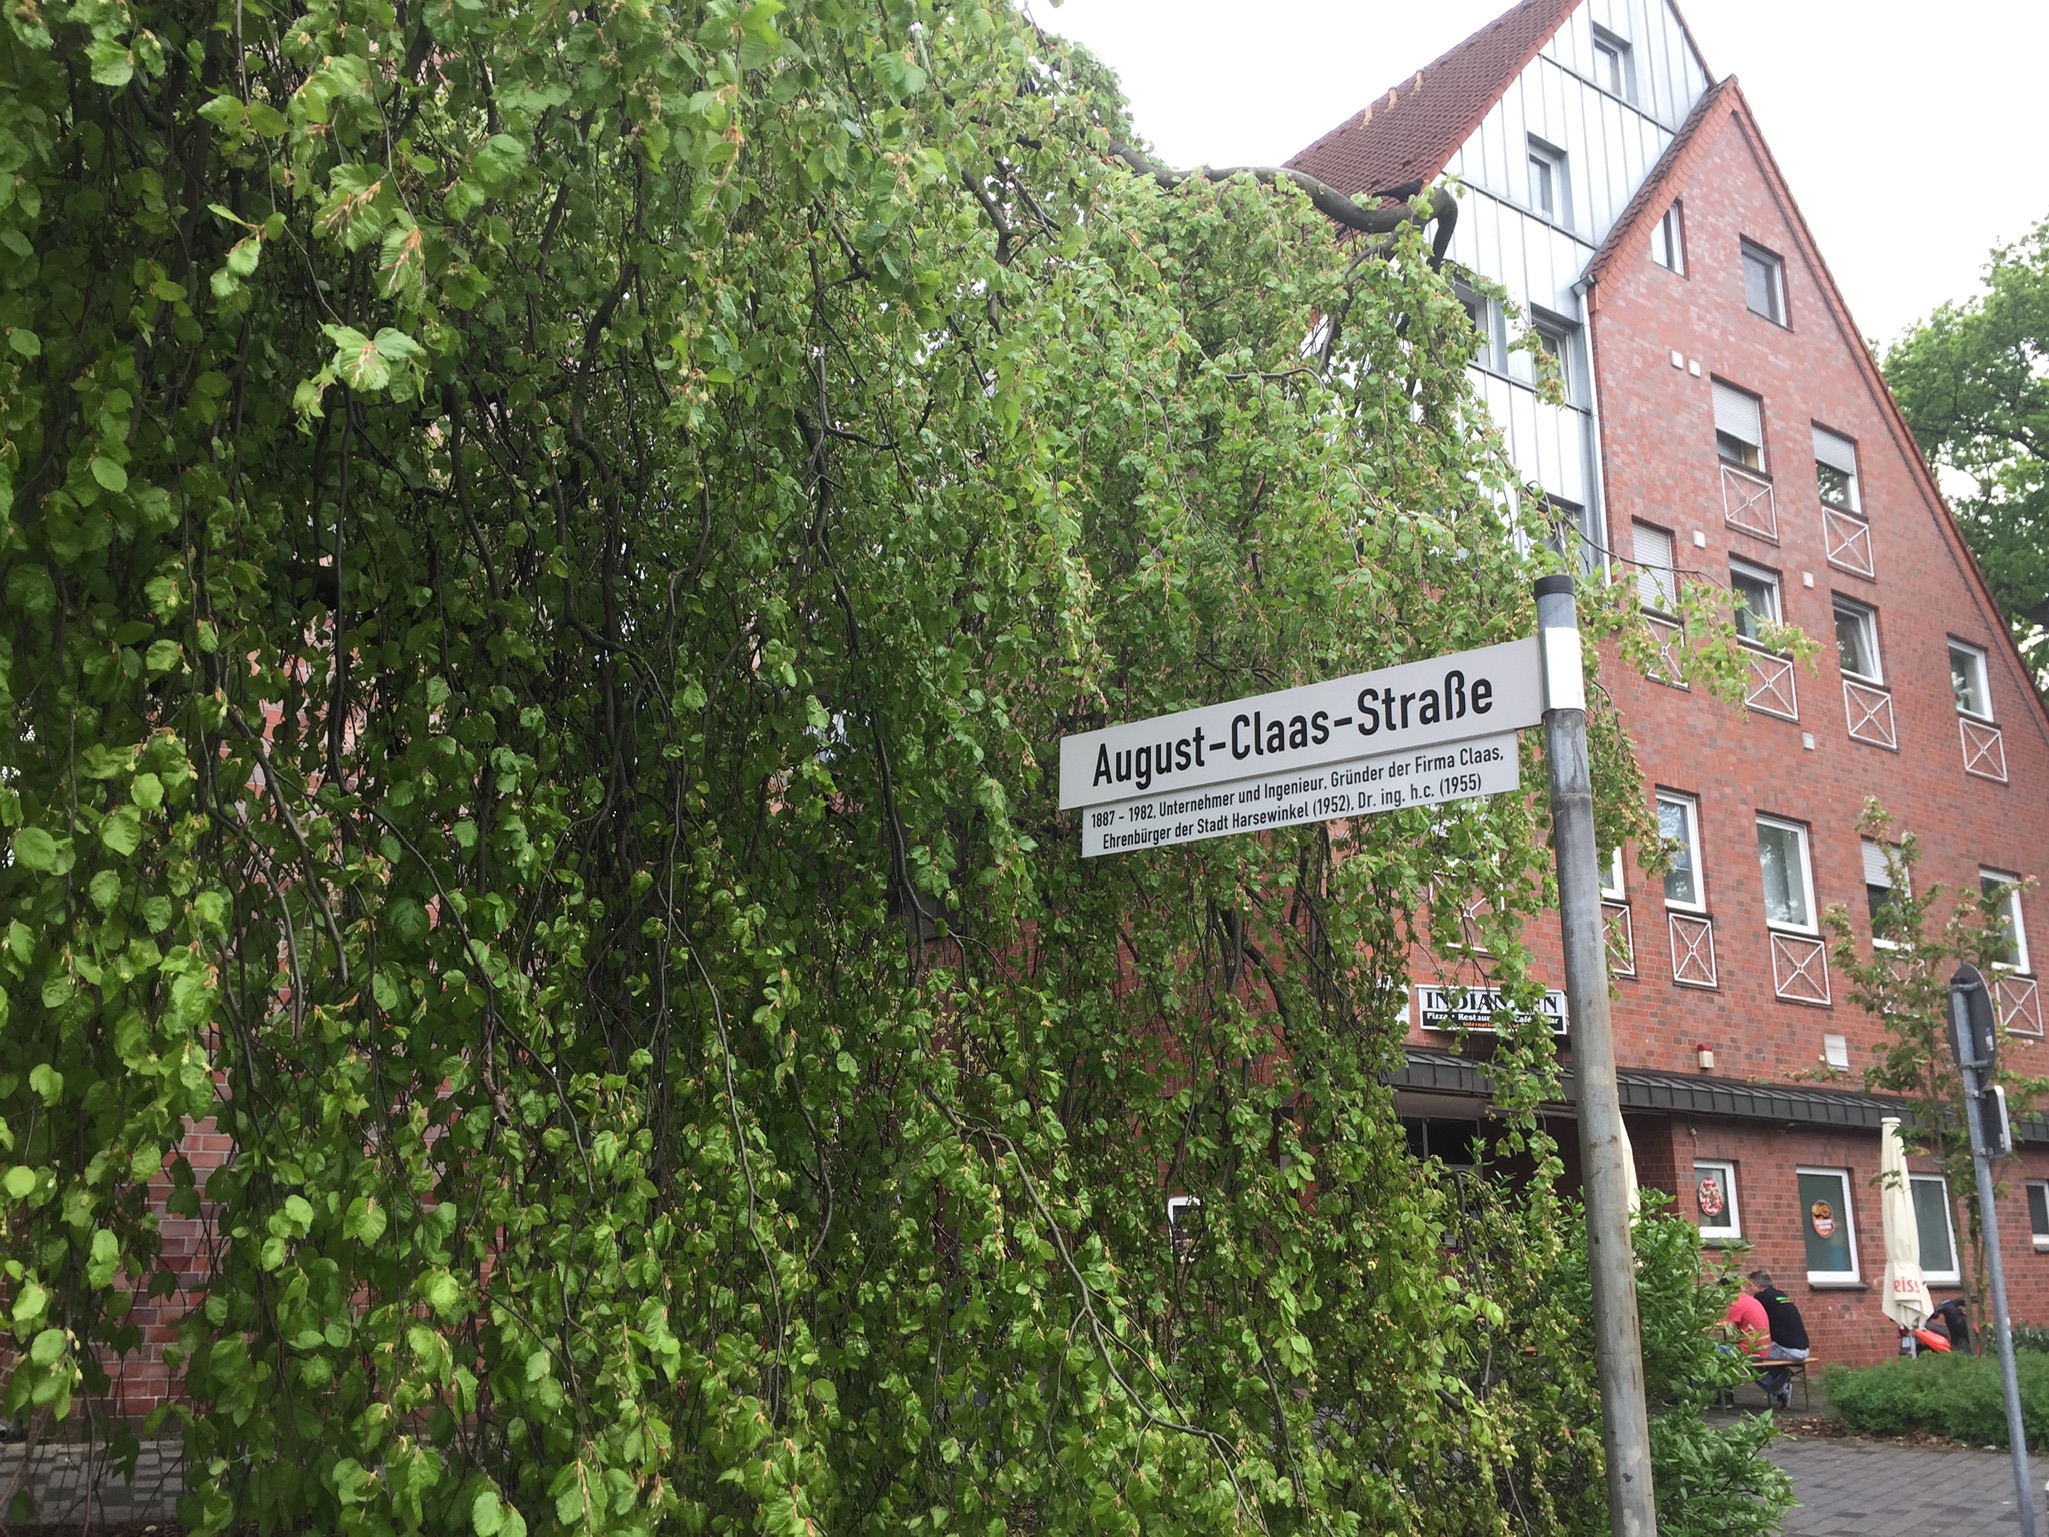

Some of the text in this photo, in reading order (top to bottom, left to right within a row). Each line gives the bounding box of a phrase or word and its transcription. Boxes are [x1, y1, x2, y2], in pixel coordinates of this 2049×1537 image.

[1092, 669, 1493, 790] August-Claas-Straße
[1091, 810, 1115, 828] 1887
[1128, 803, 1157, 822] 1982,
[1159, 791, 1235, 817] Unternehmer
[1238, 785, 1260, 803] und
[1264, 776, 1327, 801] Ingenieur,
[1330, 765, 1384, 788] Gründer
[1388, 761, 1411, 778] der
[1415, 753, 1455, 774] Firma
[1459, 746, 1504, 766] Claas,
[1103, 772, 1482, 850] Ehrenbürger der Stadt Harsewinkel (1952), Dr. ing. h.c. (1955)
[1458, 1013, 1496, 1022] Restaur
